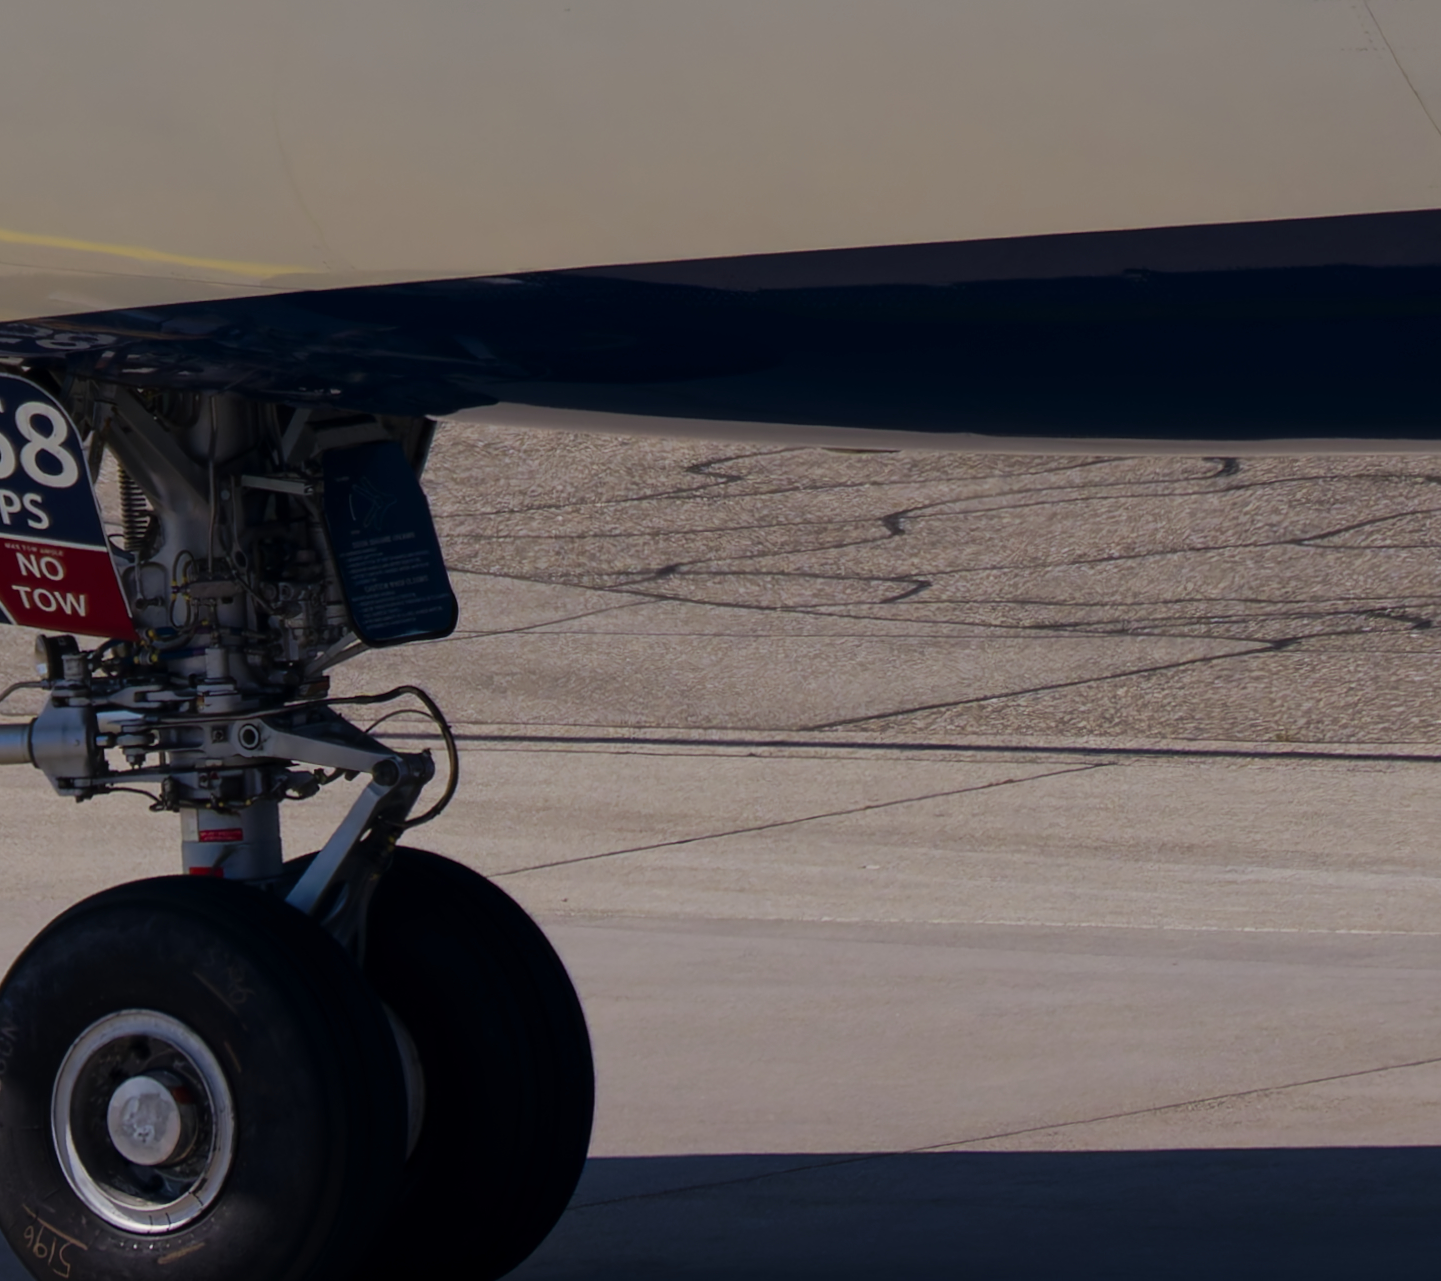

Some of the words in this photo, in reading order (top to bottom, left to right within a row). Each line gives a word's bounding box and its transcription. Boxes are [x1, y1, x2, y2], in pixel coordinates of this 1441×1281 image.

[16, 552, 64, 582] NO
[12, 584, 86, 617] TOW
[23, 1225, 71, 1278] 5196
